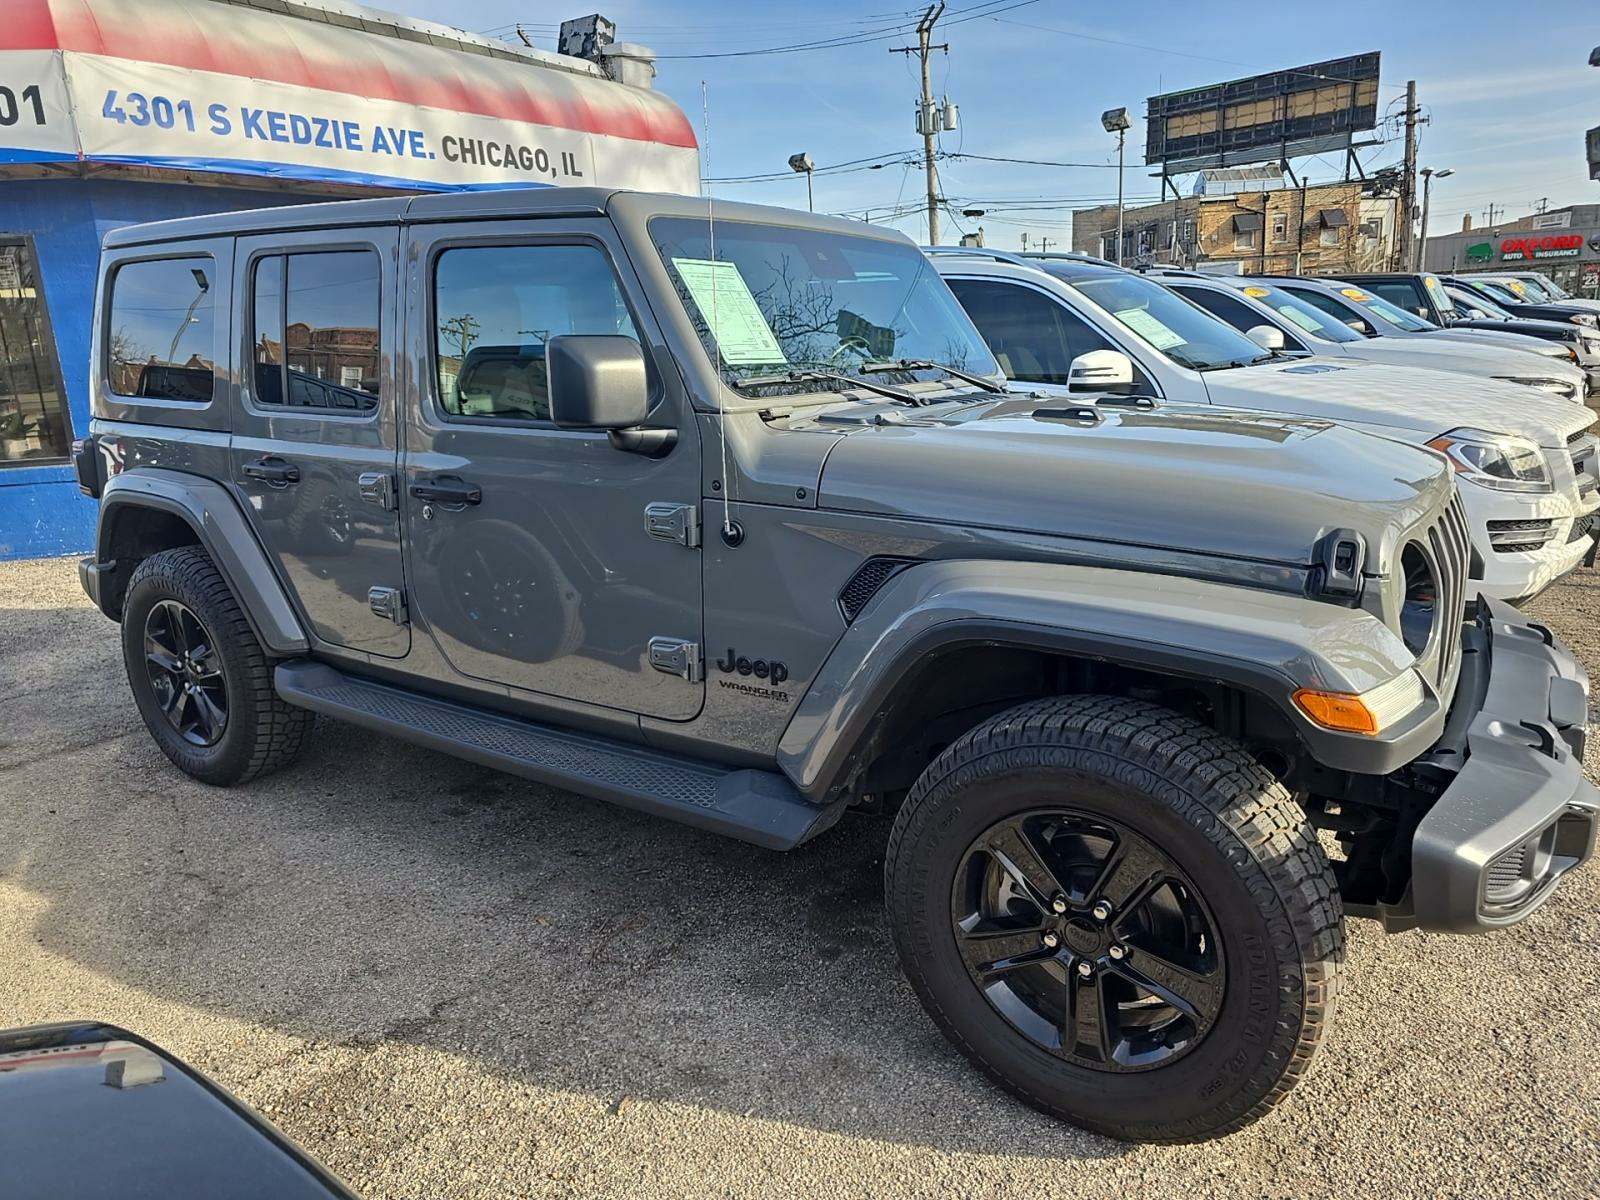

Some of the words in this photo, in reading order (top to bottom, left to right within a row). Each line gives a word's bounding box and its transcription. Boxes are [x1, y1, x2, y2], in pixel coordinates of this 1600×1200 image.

[102, 89, 195, 132] 4301
[208, 103, 232, 136] S
[240, 107, 363, 152] KEDZIE
[371, 126, 436, 160] AVE.
[441, 135, 556, 179] CHICAGO,
[561, 151, 583, 177] IL
[1501, 234, 1584, 261] OXFORD
[1502, 252, 1523, 260] AUTO
[1535, 249, 1579, 258] INSURANCE
[716, 646, 788, 686] Jeep
[719, 679, 790, 699] WRANGLER
